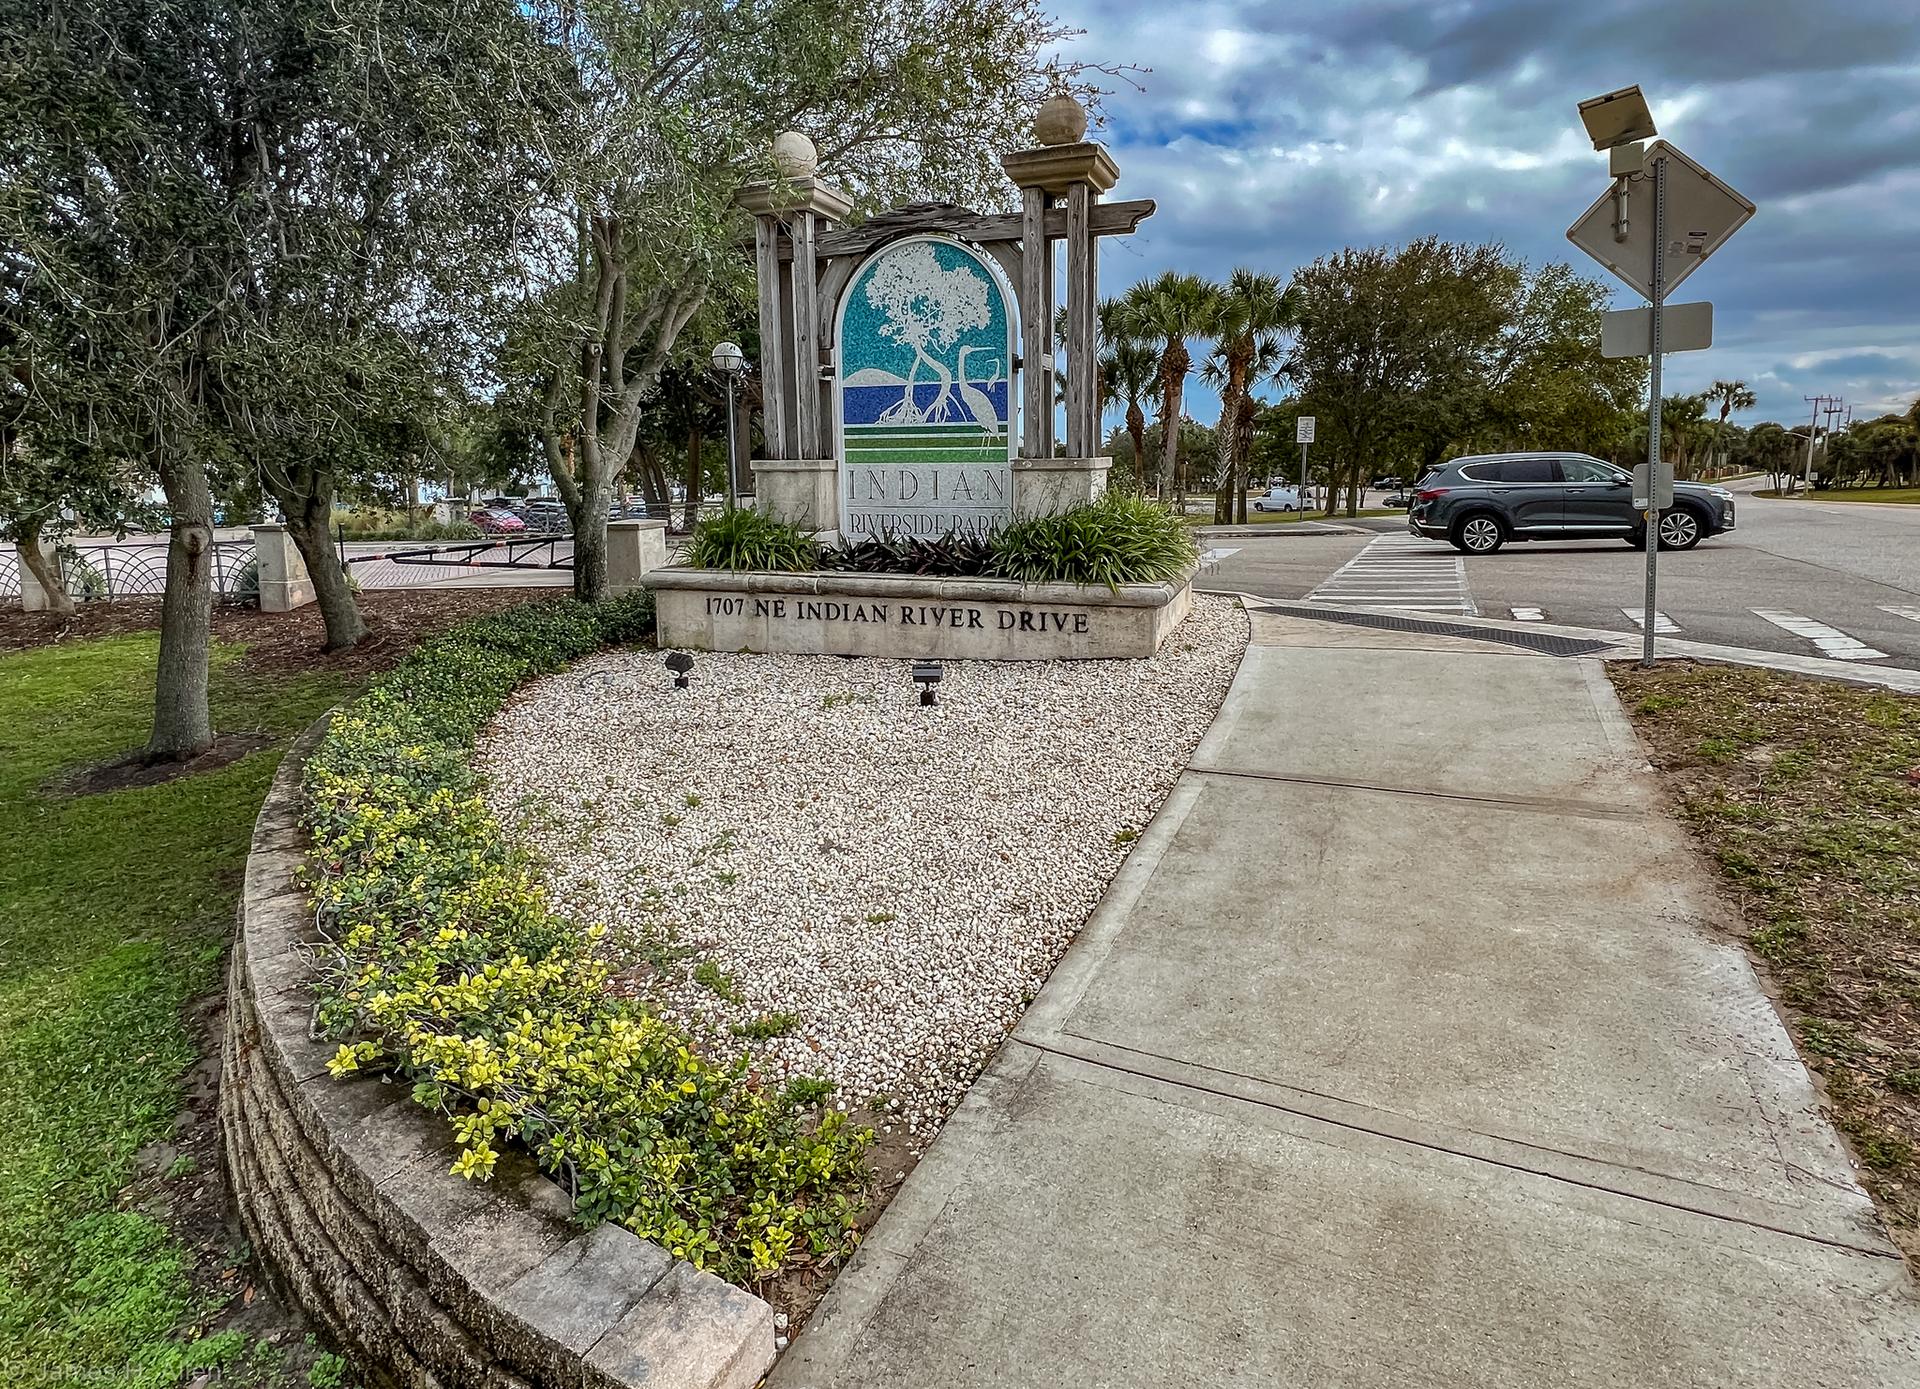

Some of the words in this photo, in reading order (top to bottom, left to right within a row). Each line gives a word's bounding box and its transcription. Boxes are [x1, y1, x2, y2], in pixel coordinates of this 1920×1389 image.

[848, 469, 1004, 501] INDIAN
[850, 513, 945, 535] RIVERSIDE
[706, 598, 744, 616] 1707
[754, 599, 787, 618] NE
[797, 601, 888, 623] INDIAN
[900, 606, 985, 629] RIVER
[998, 610, 1090, 634] DRIVE
